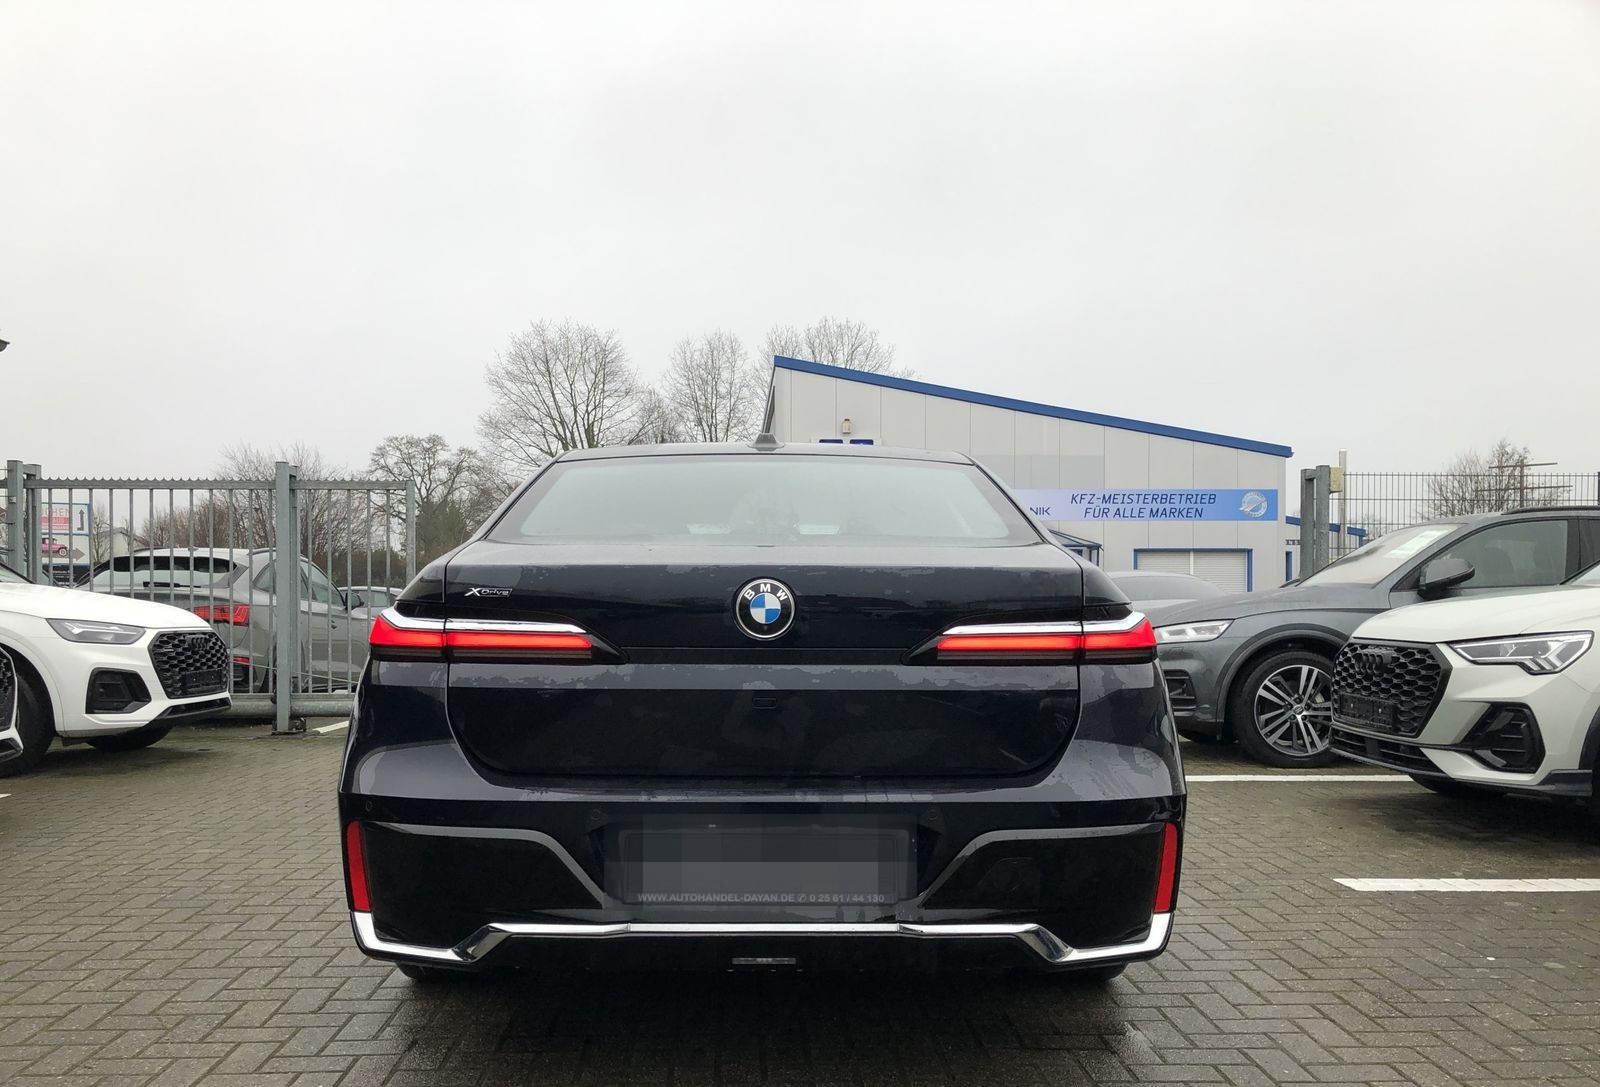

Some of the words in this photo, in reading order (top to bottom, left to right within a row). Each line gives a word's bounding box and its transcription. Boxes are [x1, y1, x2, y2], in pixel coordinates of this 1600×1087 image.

[1070, 493, 1217, 505] KFZ-MEISTERBETRIEB
[1084, 505, 1110, 519] FÜR
[1112, 507, 1146, 519] ALLE
[1149, 507, 1204, 519] MARKEN
[743, 583, 788, 601] BMW
[637, 893, 795, 902] WWW.AUTOHANDEL-DAYAN.DE
[818, 893, 830, 903] 25
[832, 893, 843, 903] 61
[851, 893, 865, 903] 44
